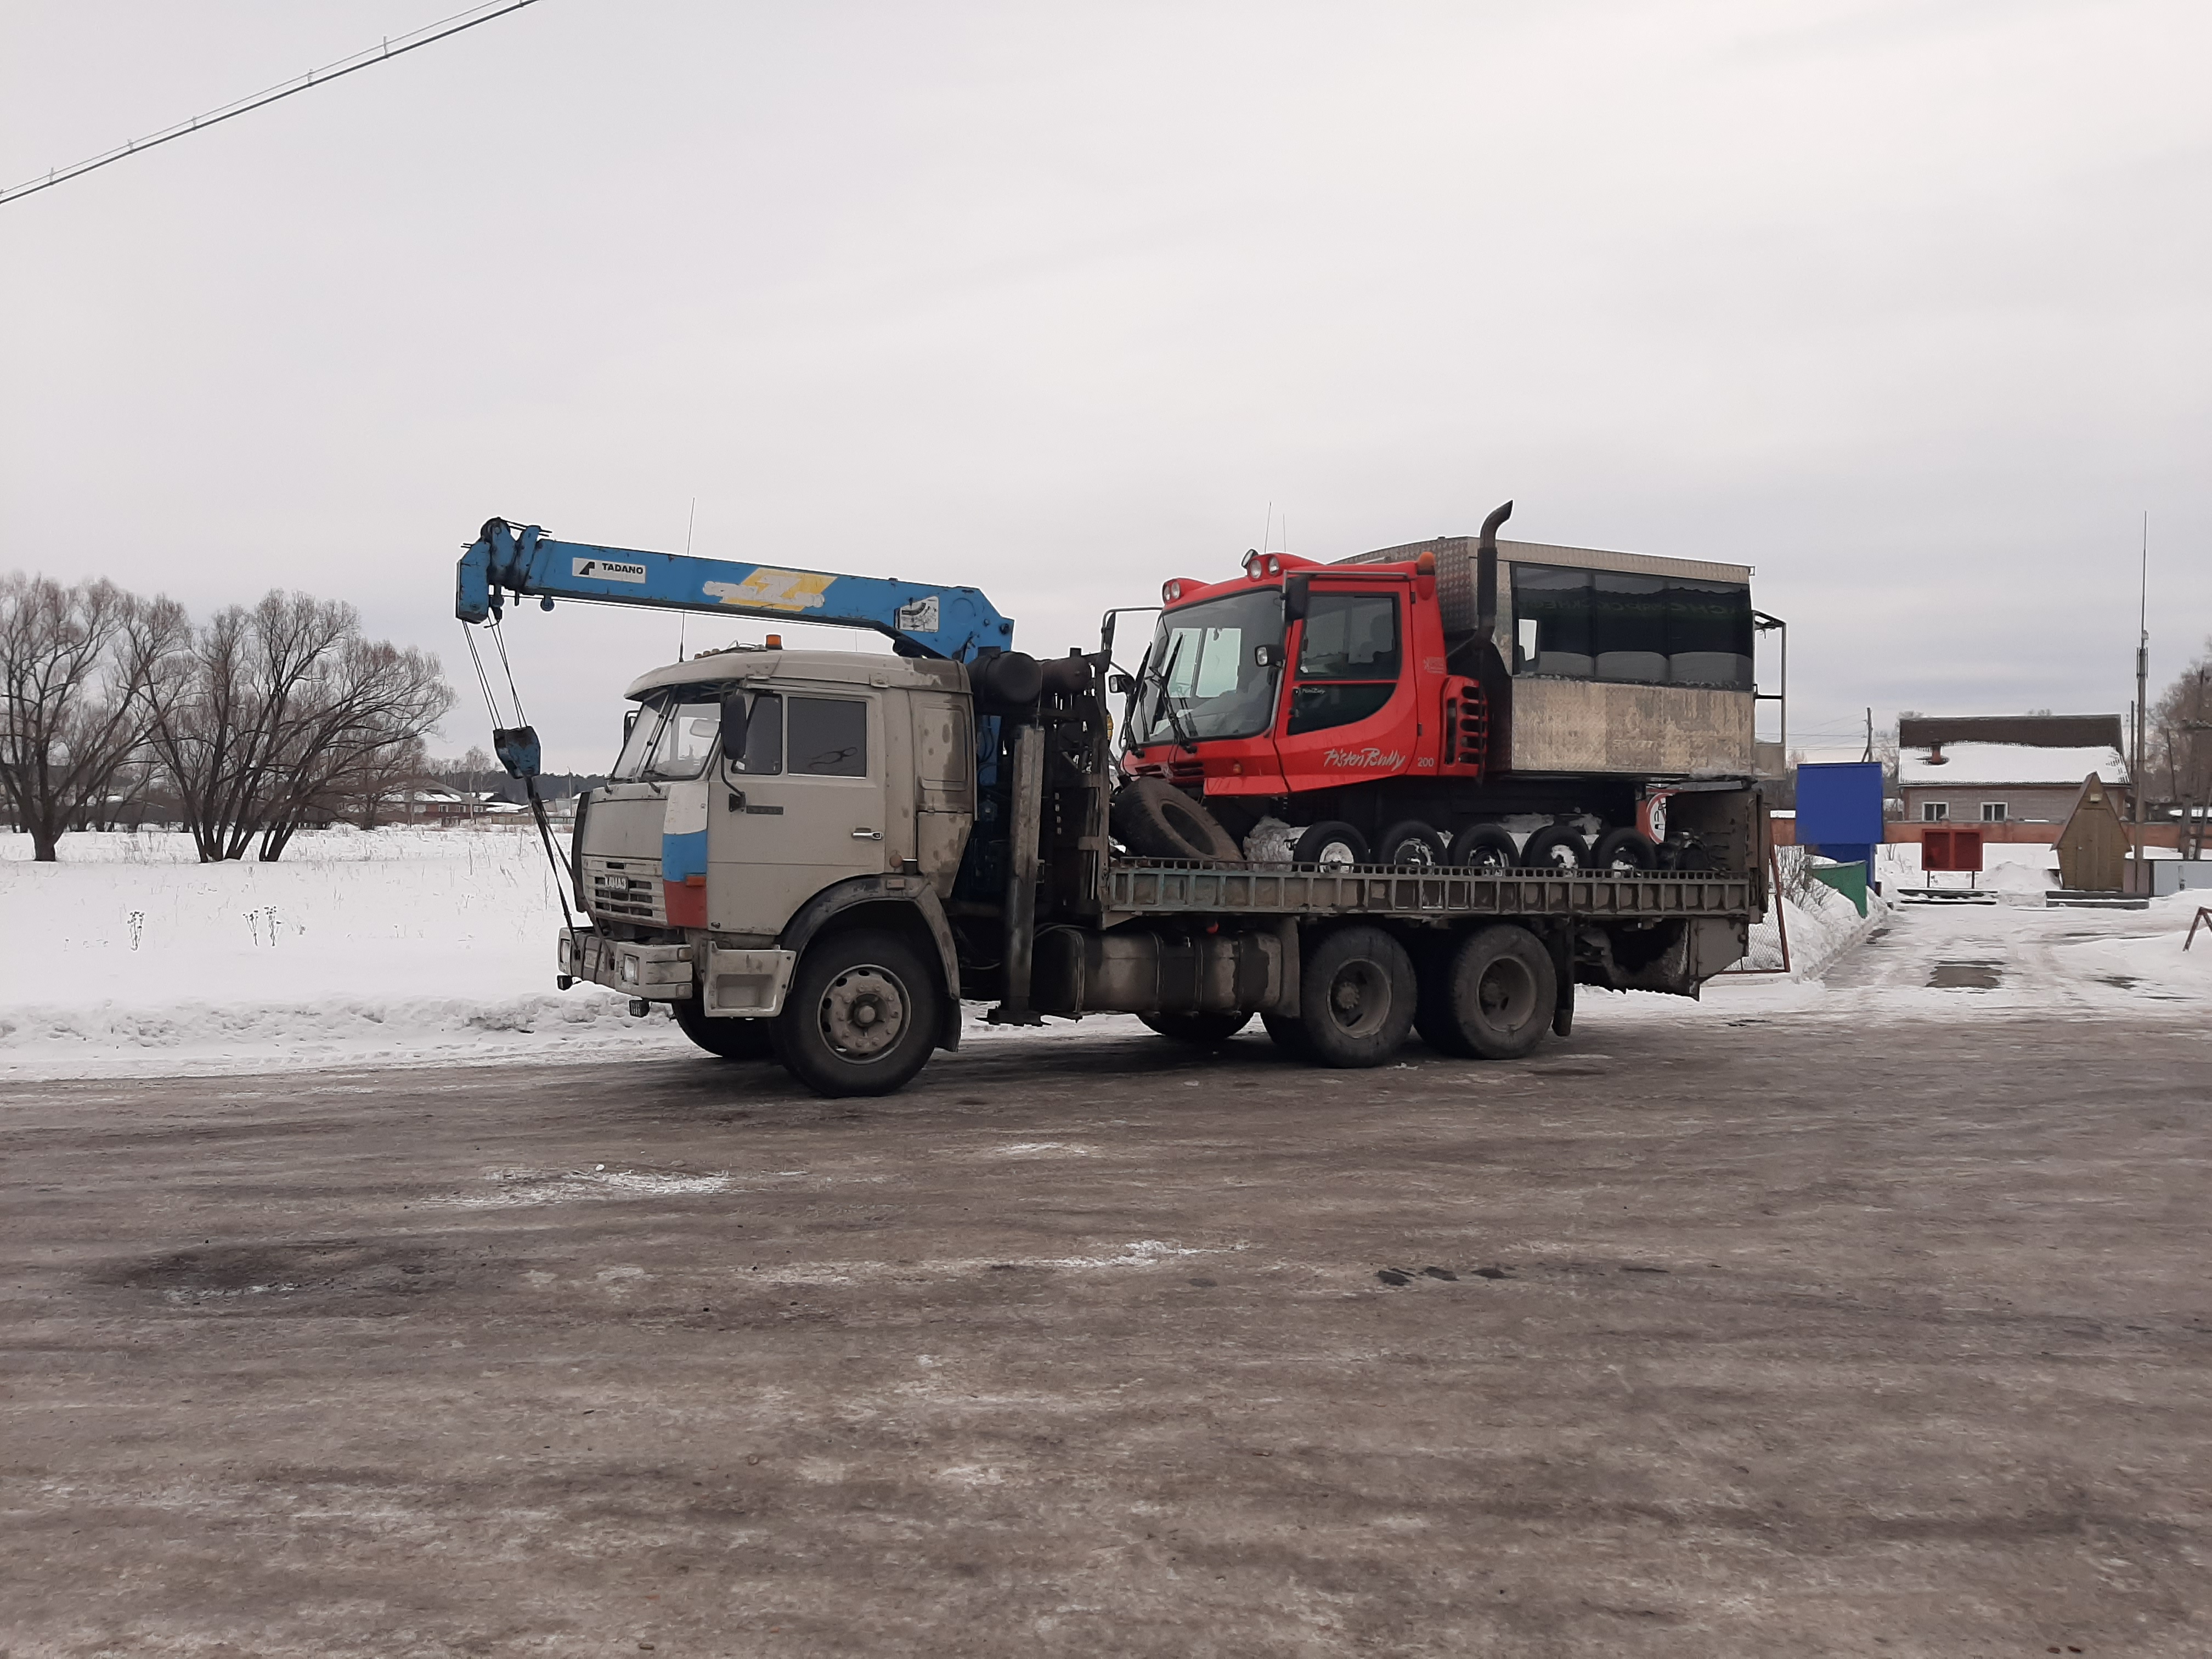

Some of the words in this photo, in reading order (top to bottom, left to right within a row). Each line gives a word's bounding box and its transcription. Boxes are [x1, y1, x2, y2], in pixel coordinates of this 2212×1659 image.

[602, 562, 644, 574] TADANO
[1323, 747, 1406, 771] PistenBully
[1418, 758, 1434, 767] 200
